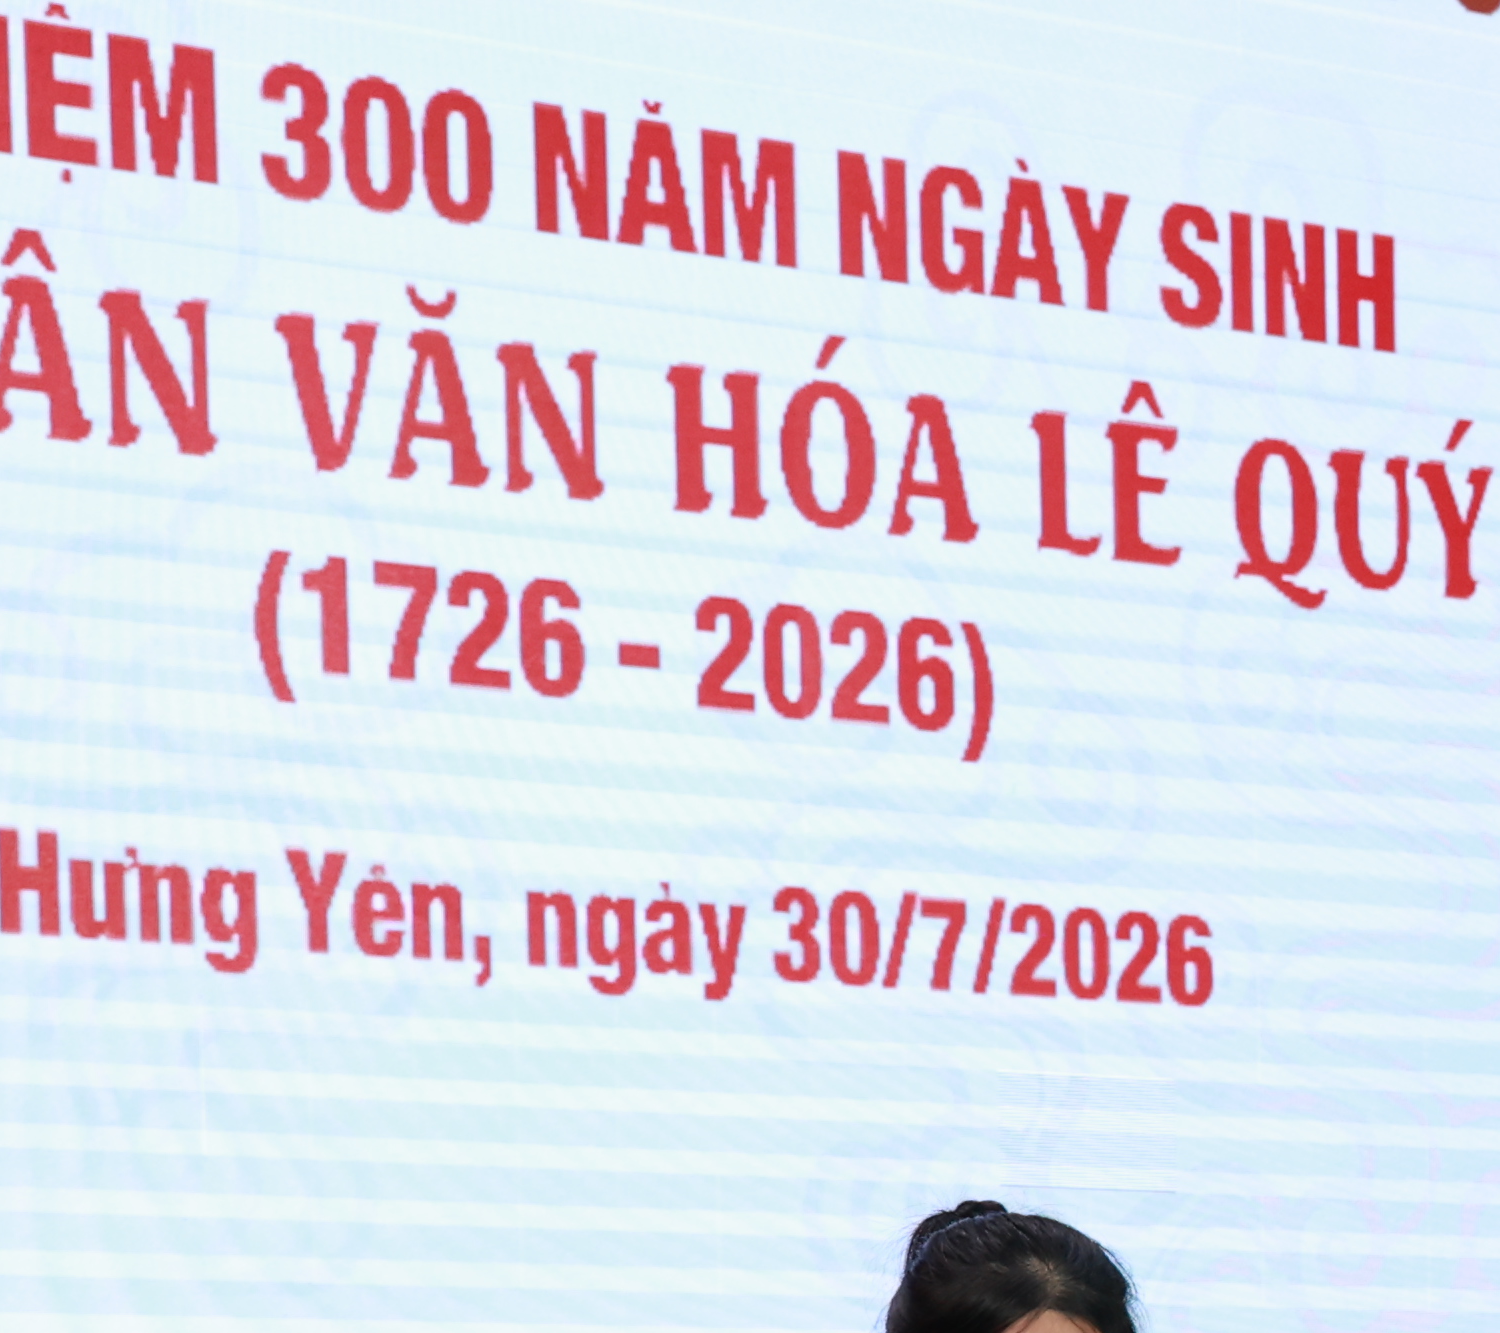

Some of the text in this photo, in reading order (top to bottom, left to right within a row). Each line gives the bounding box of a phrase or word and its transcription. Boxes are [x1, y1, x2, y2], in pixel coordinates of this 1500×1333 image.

[261, 62, 494, 225] 300
[533, 102, 798, 269] NĂM
[837, 150, 1130, 313] NGÀY
[1160, 202, 1397, 354] SINH
[275, 286, 605, 501] VĂN
[666, 335, 980, 544] HÓA
[1030, 380, 1182, 567] LÊ
[1234, 418, 1493, 610] QUÝ
[254, 550, 996, 764] (1726 - 2026)
[285, 847, 493, 986] Yên,
[526, 882, 748, 1001] ngày
[773, 886, 1214, 1008] 30/7/2026
